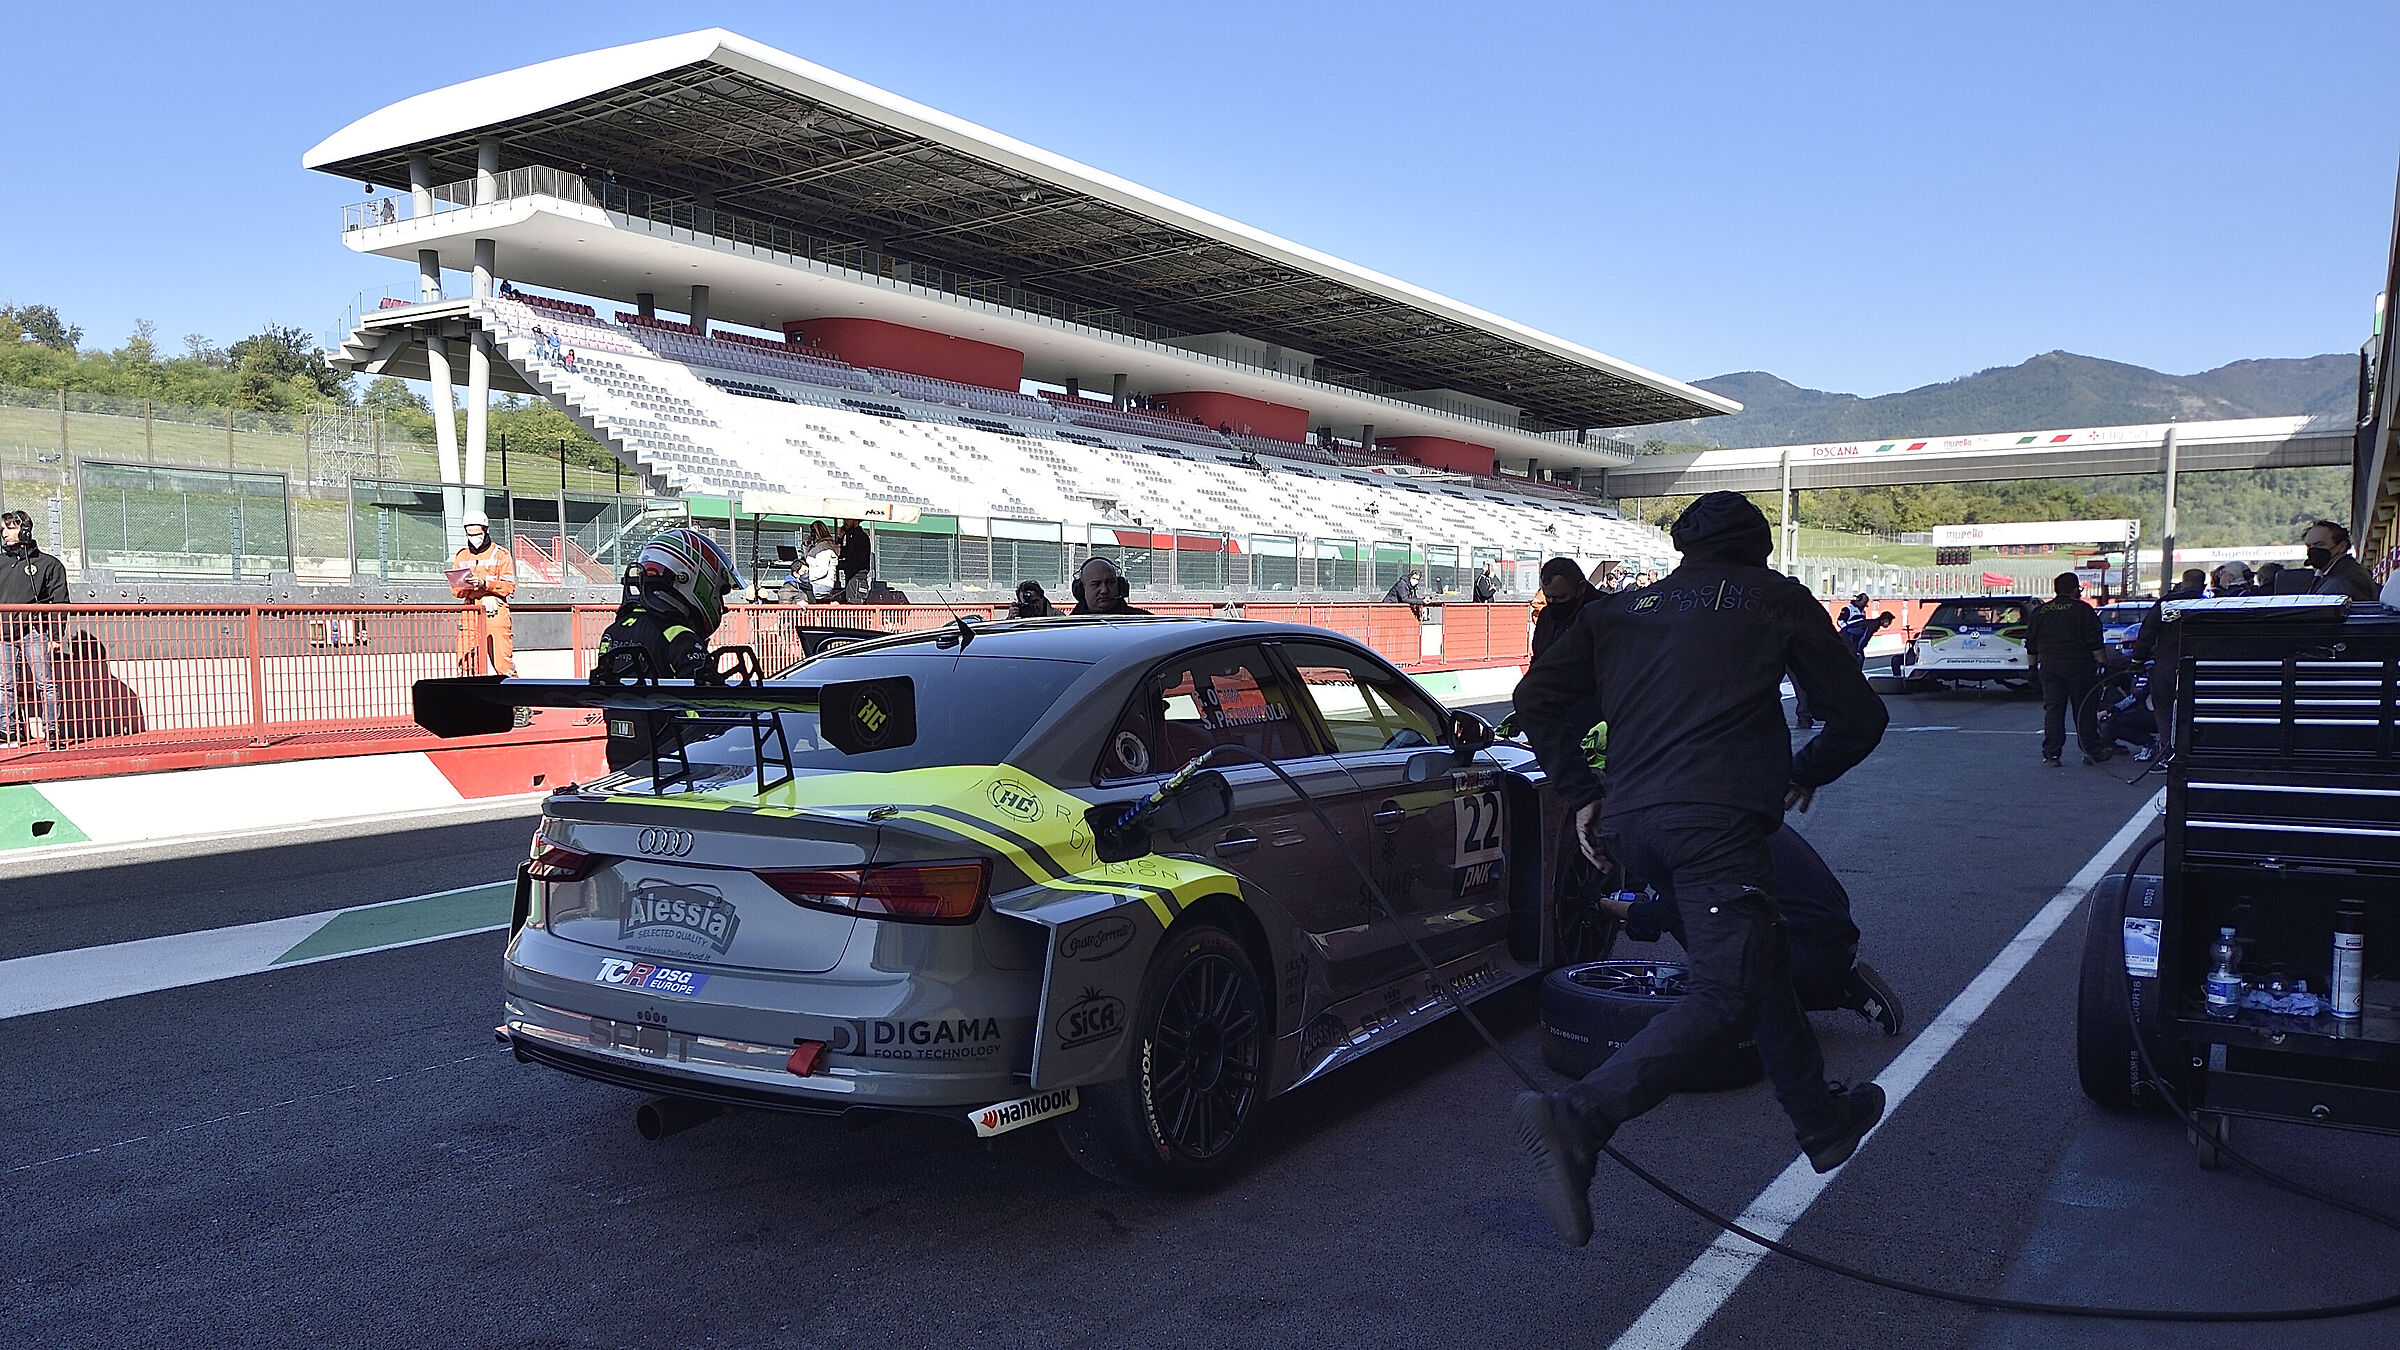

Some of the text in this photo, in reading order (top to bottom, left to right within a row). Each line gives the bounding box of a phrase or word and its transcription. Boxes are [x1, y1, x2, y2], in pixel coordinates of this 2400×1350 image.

[1634, 595, 1660, 611] HC
[857, 699, 887, 732] HC
[1000, 789, 1033, 813] HC
[1463, 792, 1500, 854] 22
[627, 892, 728, 940] Alessia
[638, 928, 709, 948] SELECTED QUALITY
[594, 957, 694, 988] TCR DSG
[649, 979, 696, 995] EUROPE
[873, 1017, 1001, 1045] DIGAMA
[874, 1044, 1001, 1059] FOOD TECHNOLOGY
